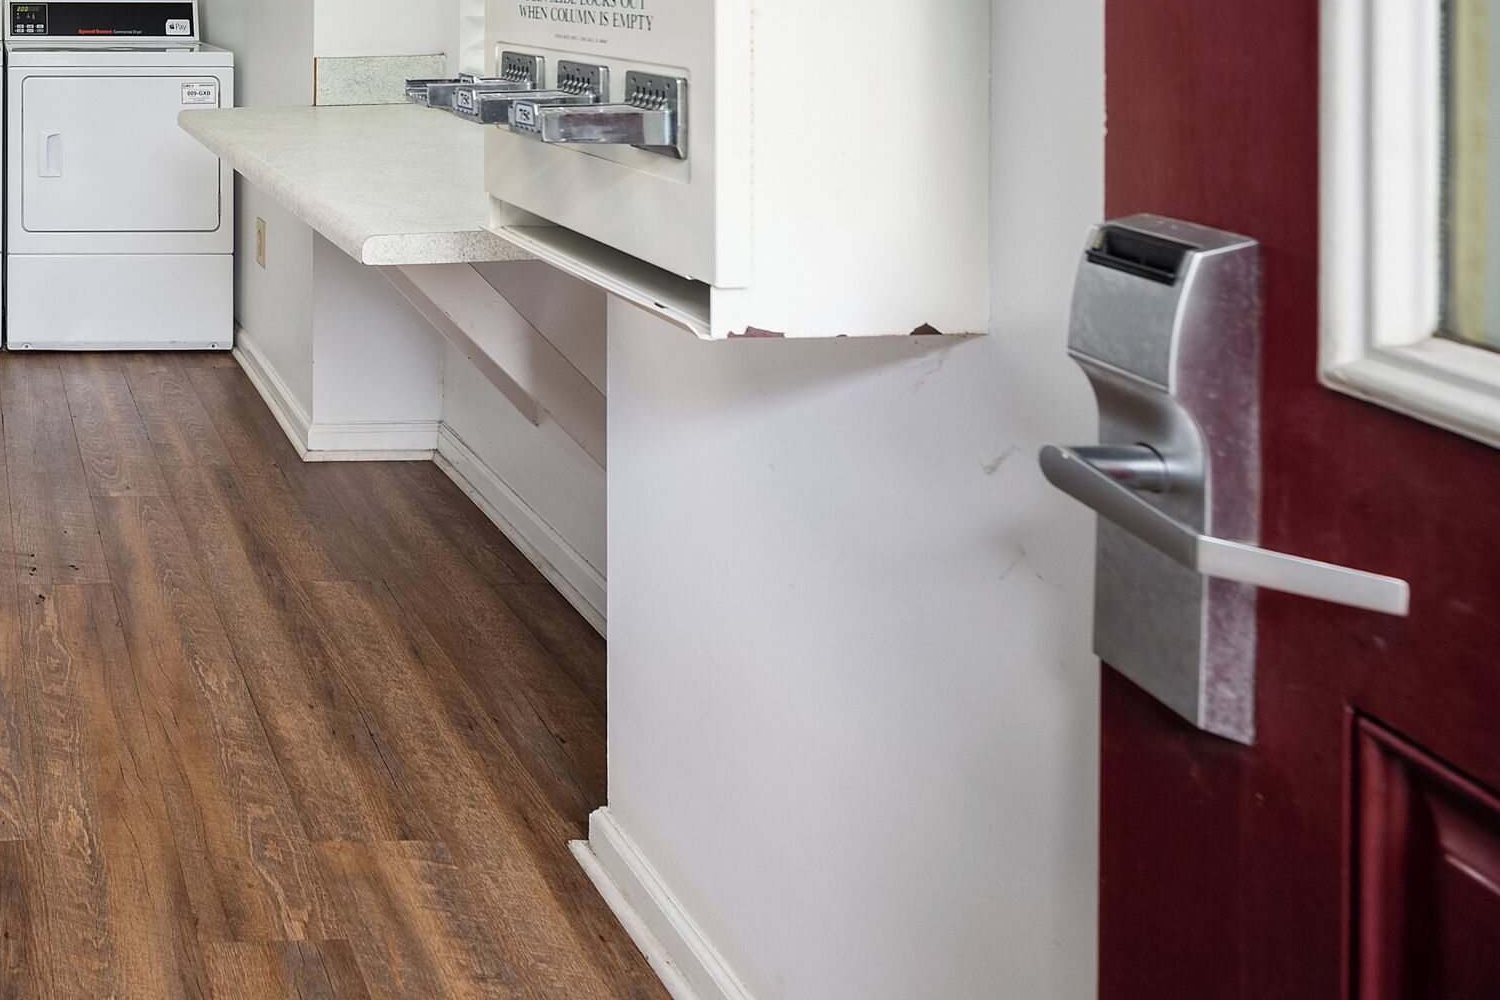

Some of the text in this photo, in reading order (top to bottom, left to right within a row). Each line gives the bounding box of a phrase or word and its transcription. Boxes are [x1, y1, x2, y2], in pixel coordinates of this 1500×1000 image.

[519, 5, 654, 31] WHEN COLUMN IS EMPTY
[176, 23, 187, 31] Pay
